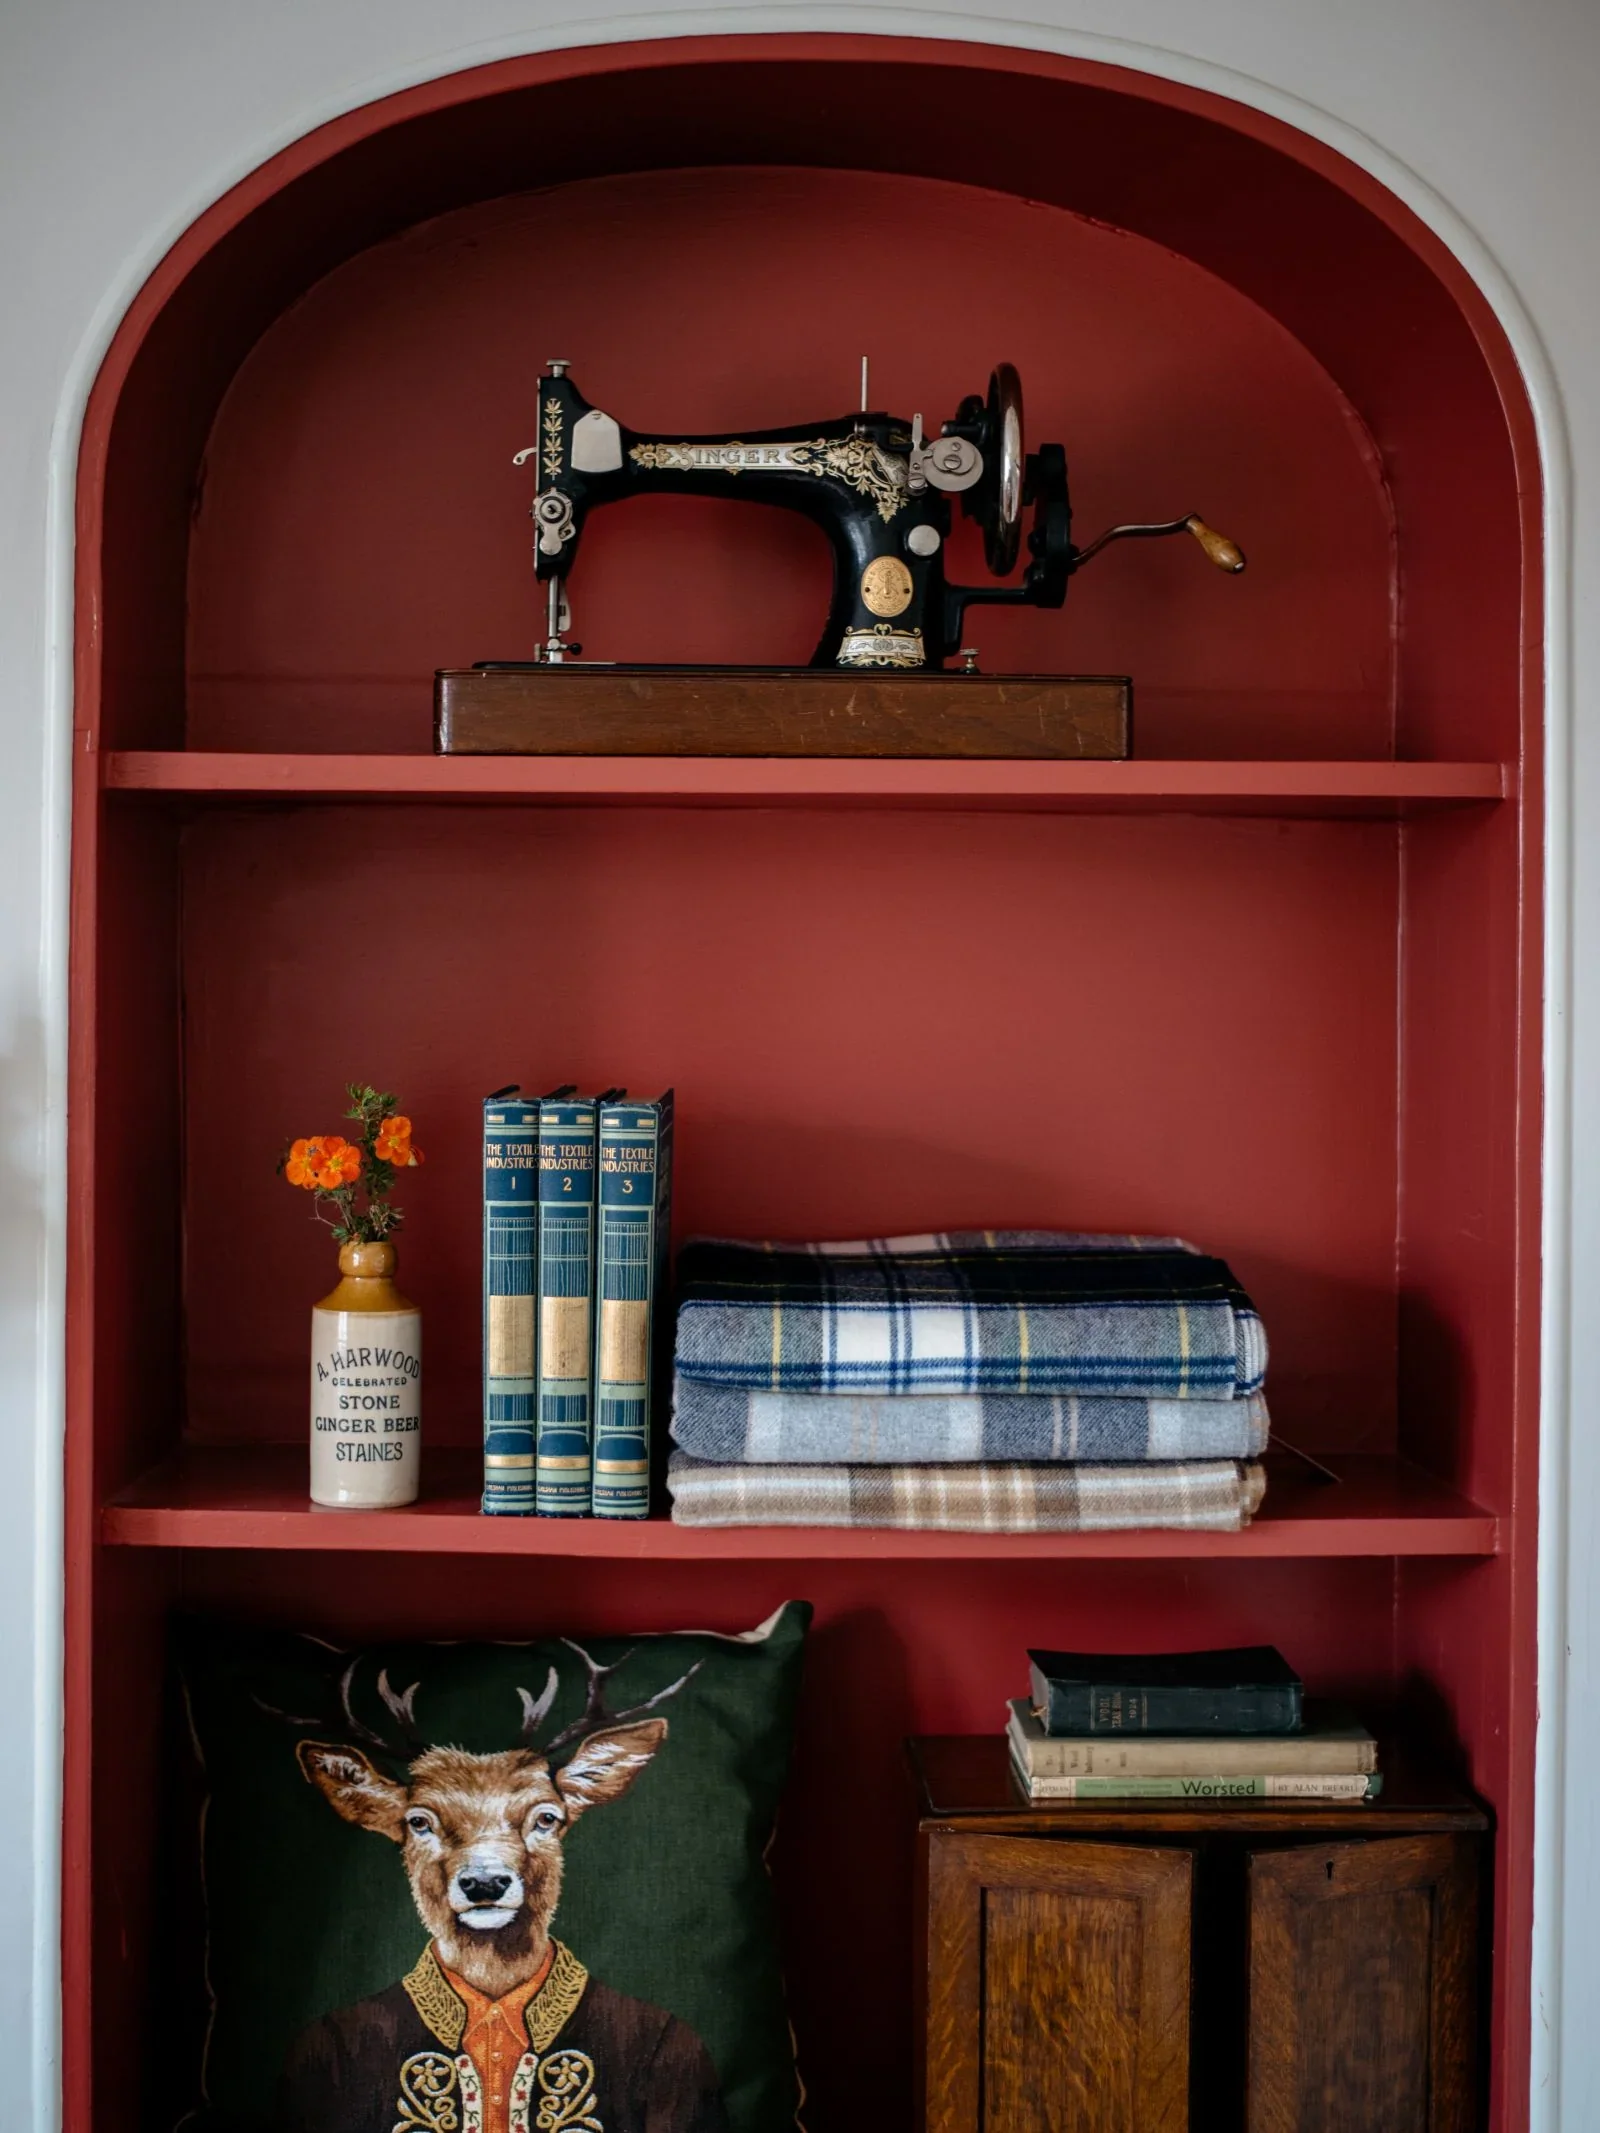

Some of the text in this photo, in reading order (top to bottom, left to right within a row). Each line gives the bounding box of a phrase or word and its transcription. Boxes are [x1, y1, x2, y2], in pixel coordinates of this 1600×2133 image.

[677, 443, 782, 470] SINGER
[486, 1144, 502, 1156] THE
[540, 1145, 593, 1157] THE TEXTILE
[602, 1147, 655, 1160] THE TEXTILE
[511, 1176, 516, 1190] 1
[563, 1177, 572, 1191] 2
[622, 1180, 633, 1194] 3
[317, 1347, 420, 1382] A. HARWOOD
[332, 1377, 407, 1387] CELEBRATED
[339, 1395, 401, 1410] STONE
[315, 1416, 420, 1433] GINGER BEER
[336, 1441, 403, 1463] STAINES
[1181, 1780, 1256, 1796] Worsted
[1278, 1783, 1288, 1792] BY
[1295, 1783, 1318, 1792] ALAN
